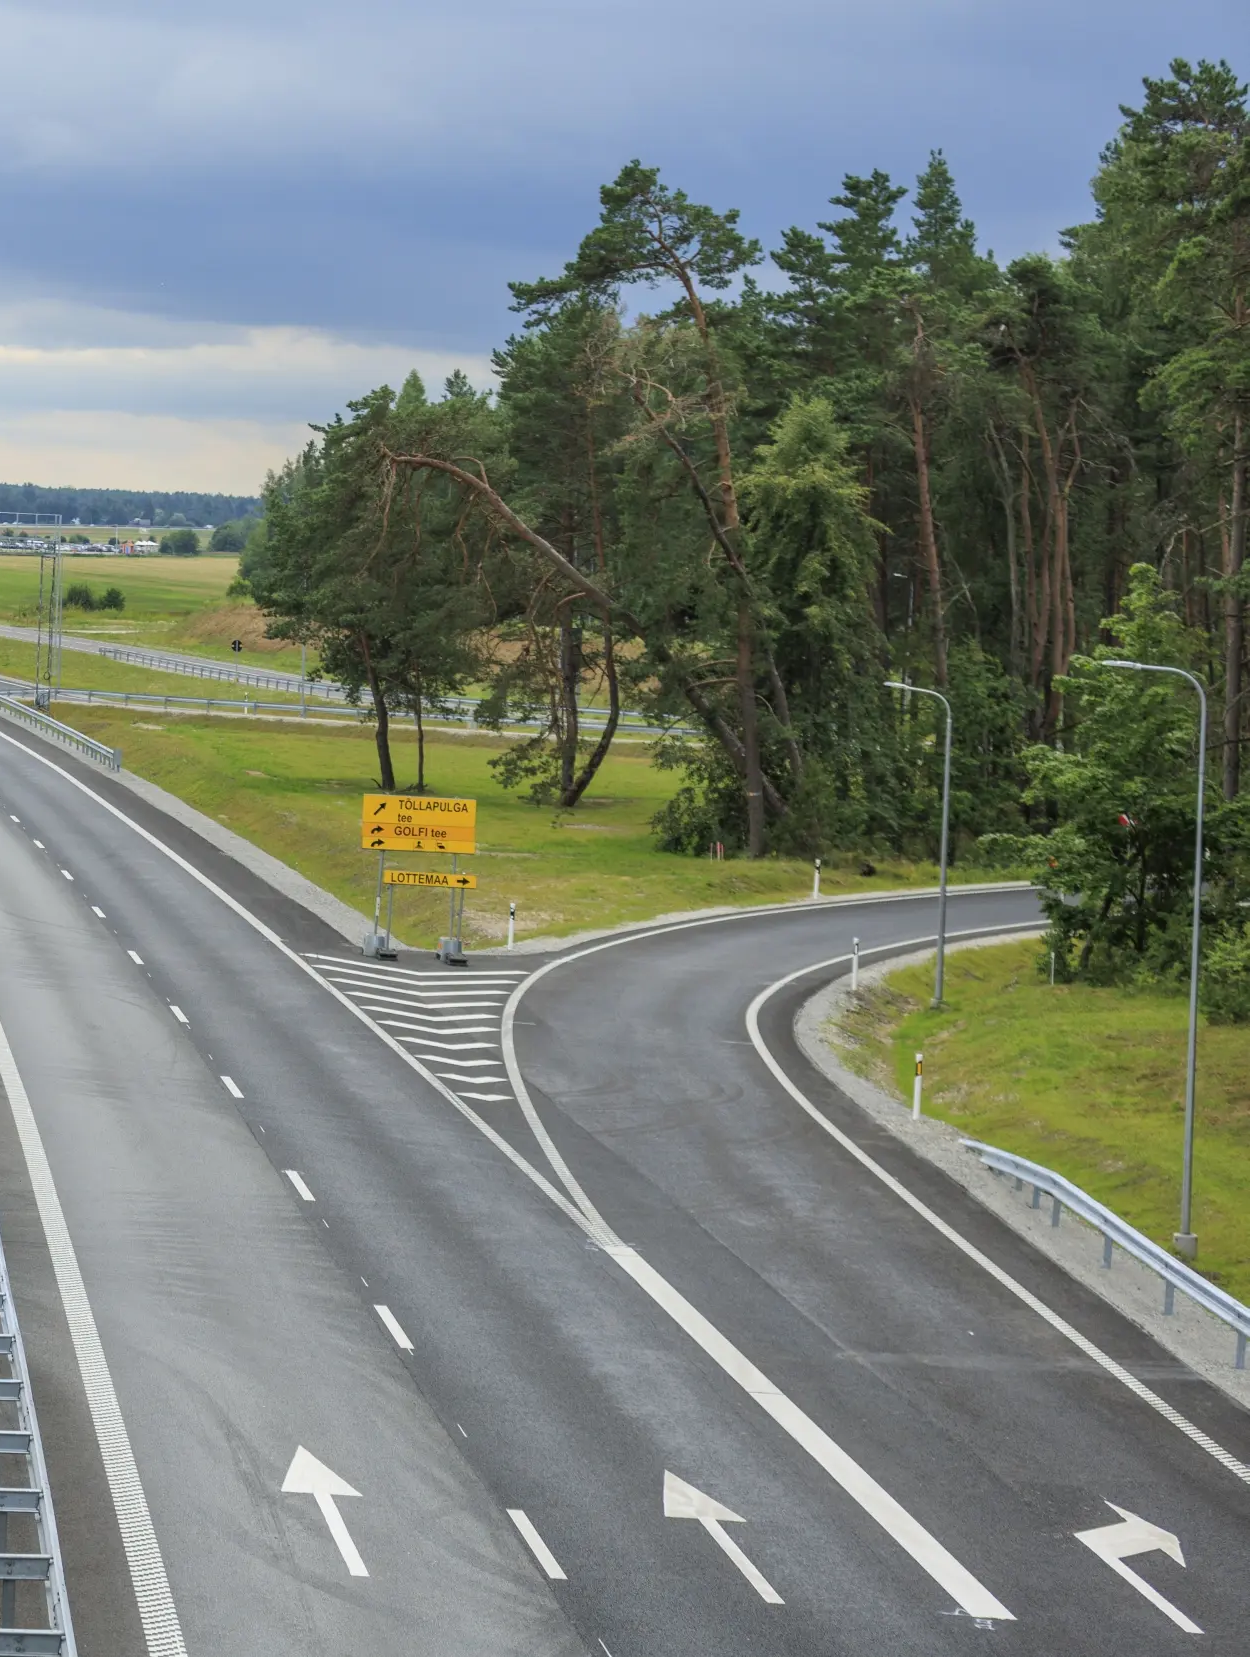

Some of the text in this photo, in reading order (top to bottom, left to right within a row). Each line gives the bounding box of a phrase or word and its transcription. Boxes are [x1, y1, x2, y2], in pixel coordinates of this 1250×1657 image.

[398, 797, 468, 813] TÕLLAPULGA
[397, 813, 413, 823] tee
[394, 825, 447, 838] GOLFI tee
[390, 872, 449, 885] LOTTEMAA
